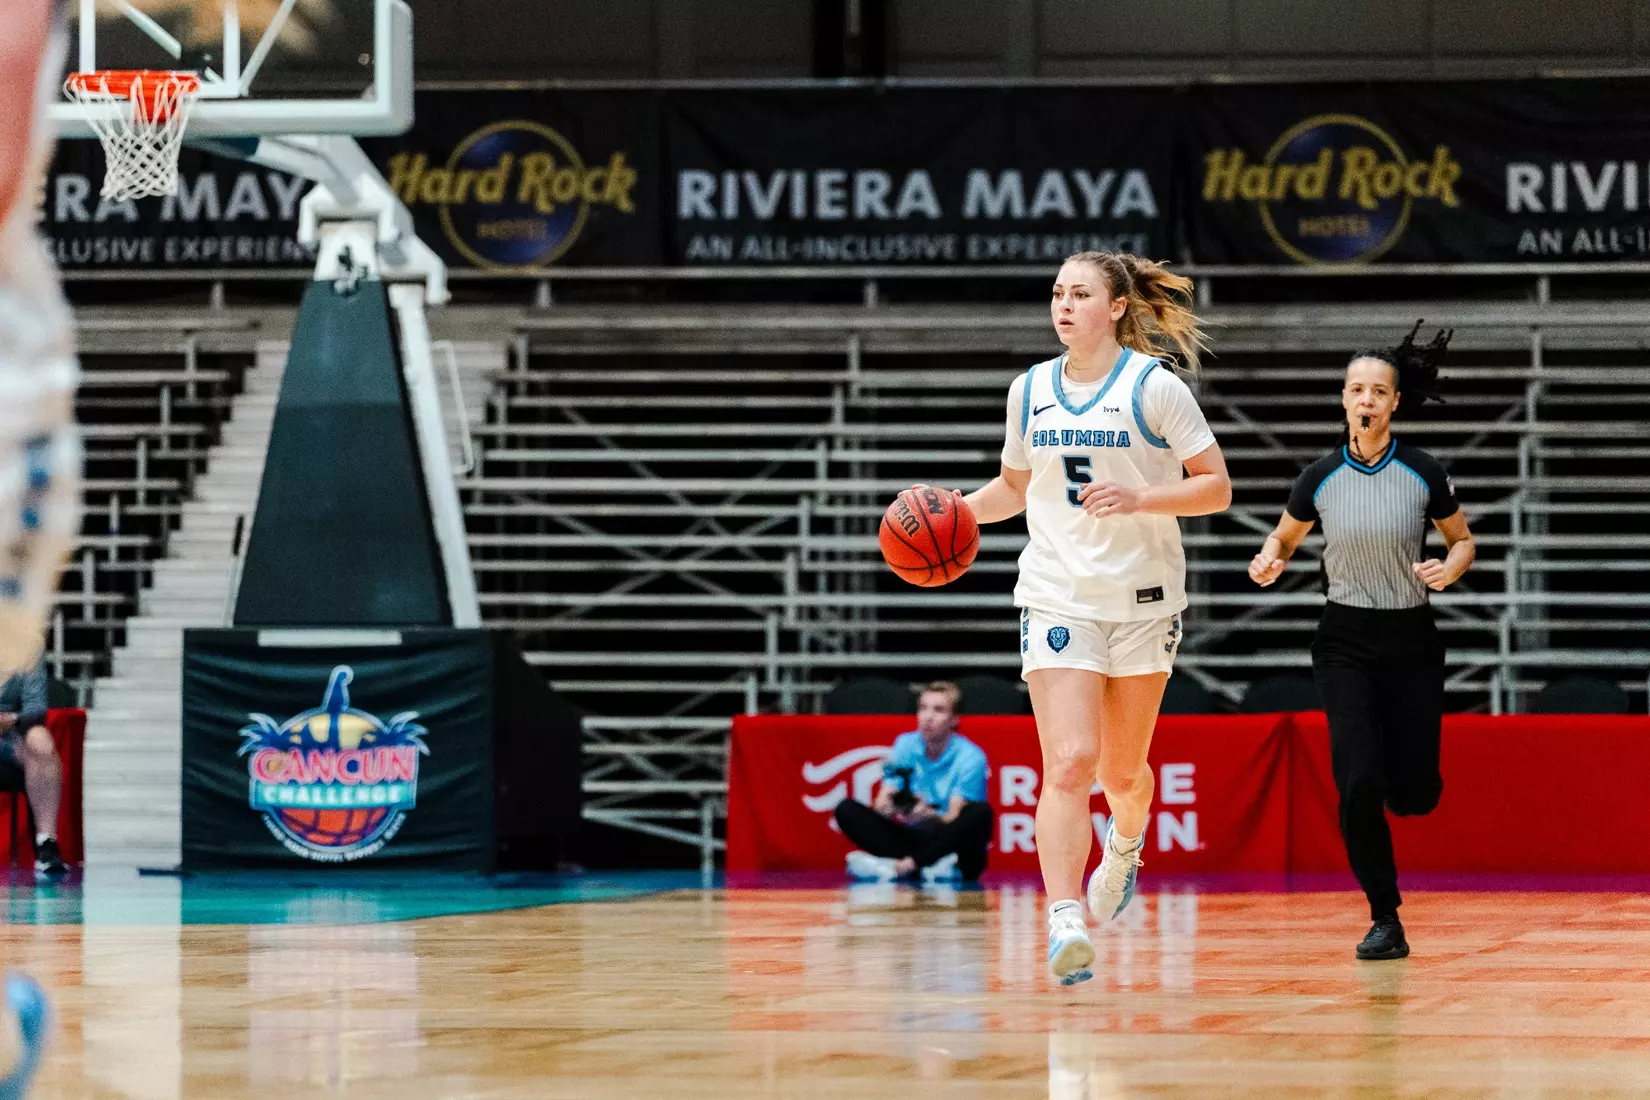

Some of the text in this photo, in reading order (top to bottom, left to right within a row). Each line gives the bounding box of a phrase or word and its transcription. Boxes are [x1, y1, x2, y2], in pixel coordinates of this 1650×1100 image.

[51, 172, 305, 222] RA MAY
[389, 152, 637, 213] Hard Rock
[677, 168, 1159, 220] RIVIERA MAYA
[1203, 145, 1462, 209] Hard Rock
[1506, 161, 1650, 213] RIVI
[48, 236, 316, 264] LUSIVE EXPERIEN
[686, 232, 1147, 260] AN ALL-INCLUSIVE EXPERIENCE
[1517, 226, 1650, 254] AN ALL-I
[1032, 430, 1131, 447] COLUMBIA
[1062, 454, 1094, 508] 5
[894, 498, 921, 538] Wils
[252, 747, 416, 784] CANCUN
[263, 784, 403, 803] CHALLENGE
